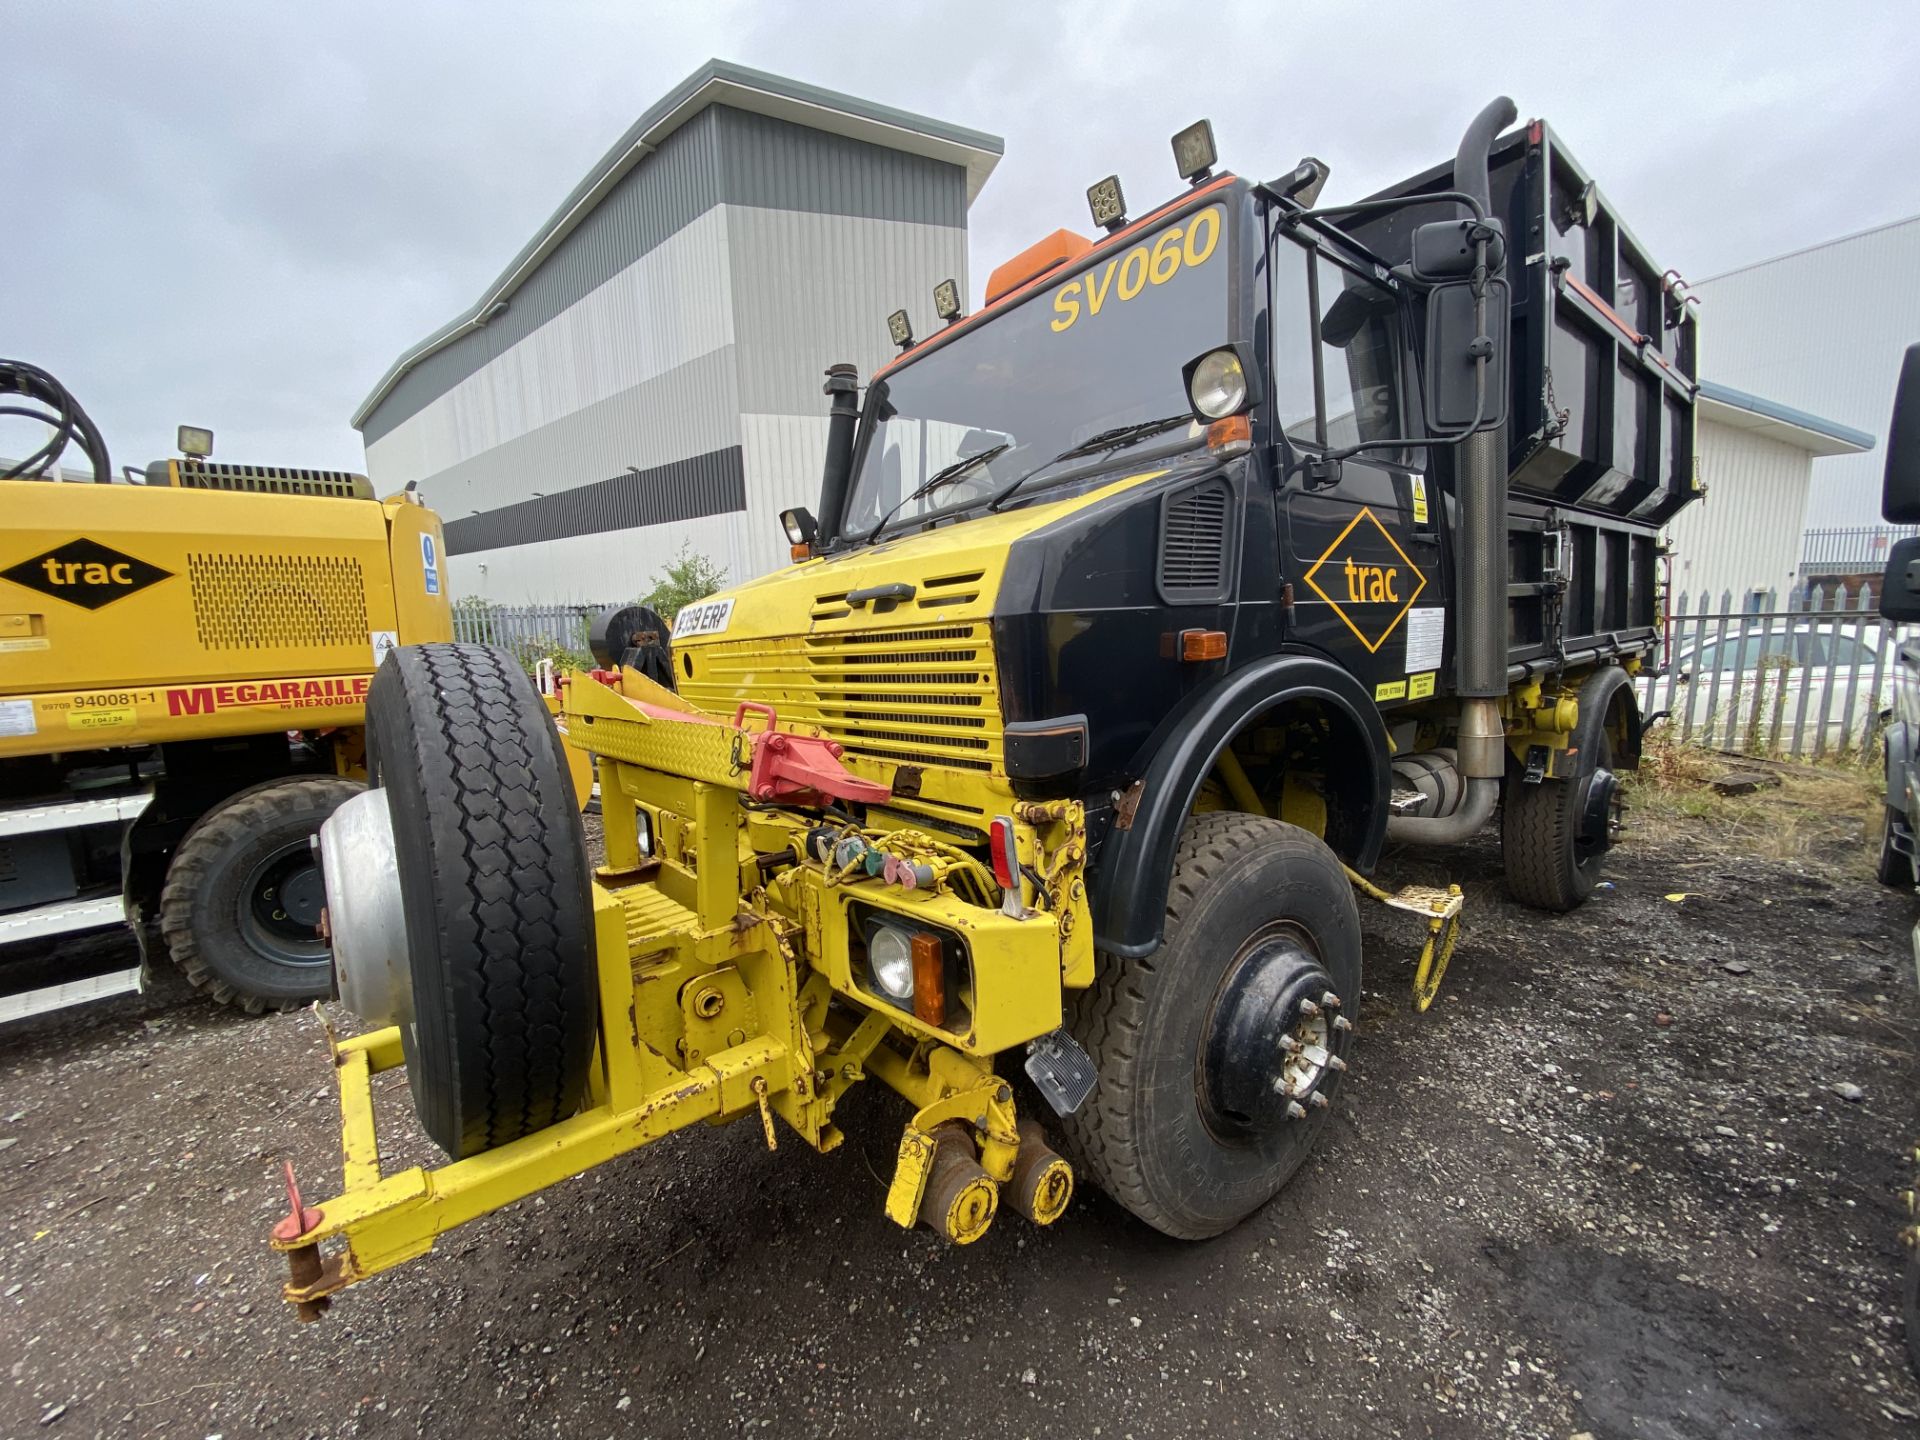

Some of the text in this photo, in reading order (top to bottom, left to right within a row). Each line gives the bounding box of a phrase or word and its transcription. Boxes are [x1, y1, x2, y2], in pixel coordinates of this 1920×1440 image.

[1051, 207, 1221, 332] SV060
[42, 558, 133, 585] trac
[1345, 556, 1399, 603] trac
[701, 603, 728, 630] ERP
[74, 691, 155, 708] 940081-1
[166, 678, 371, 716] MEGARAILE
